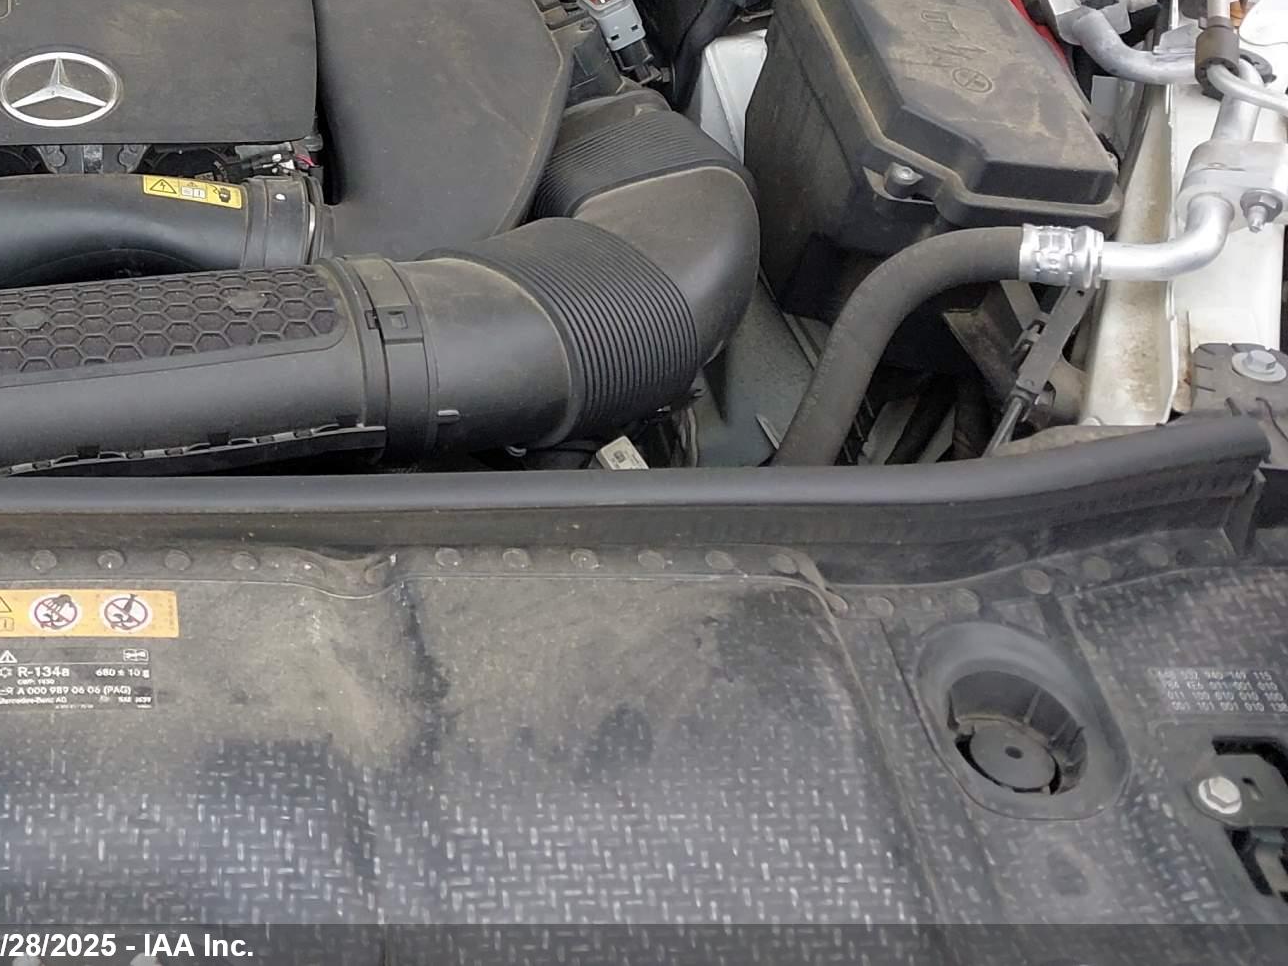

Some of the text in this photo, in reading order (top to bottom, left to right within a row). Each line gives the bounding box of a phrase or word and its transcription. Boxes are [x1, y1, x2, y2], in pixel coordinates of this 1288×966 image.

[128, 668, 141, 677] 10
[17, 686, 132, 695] A 000 989 06 06 (PAG)
